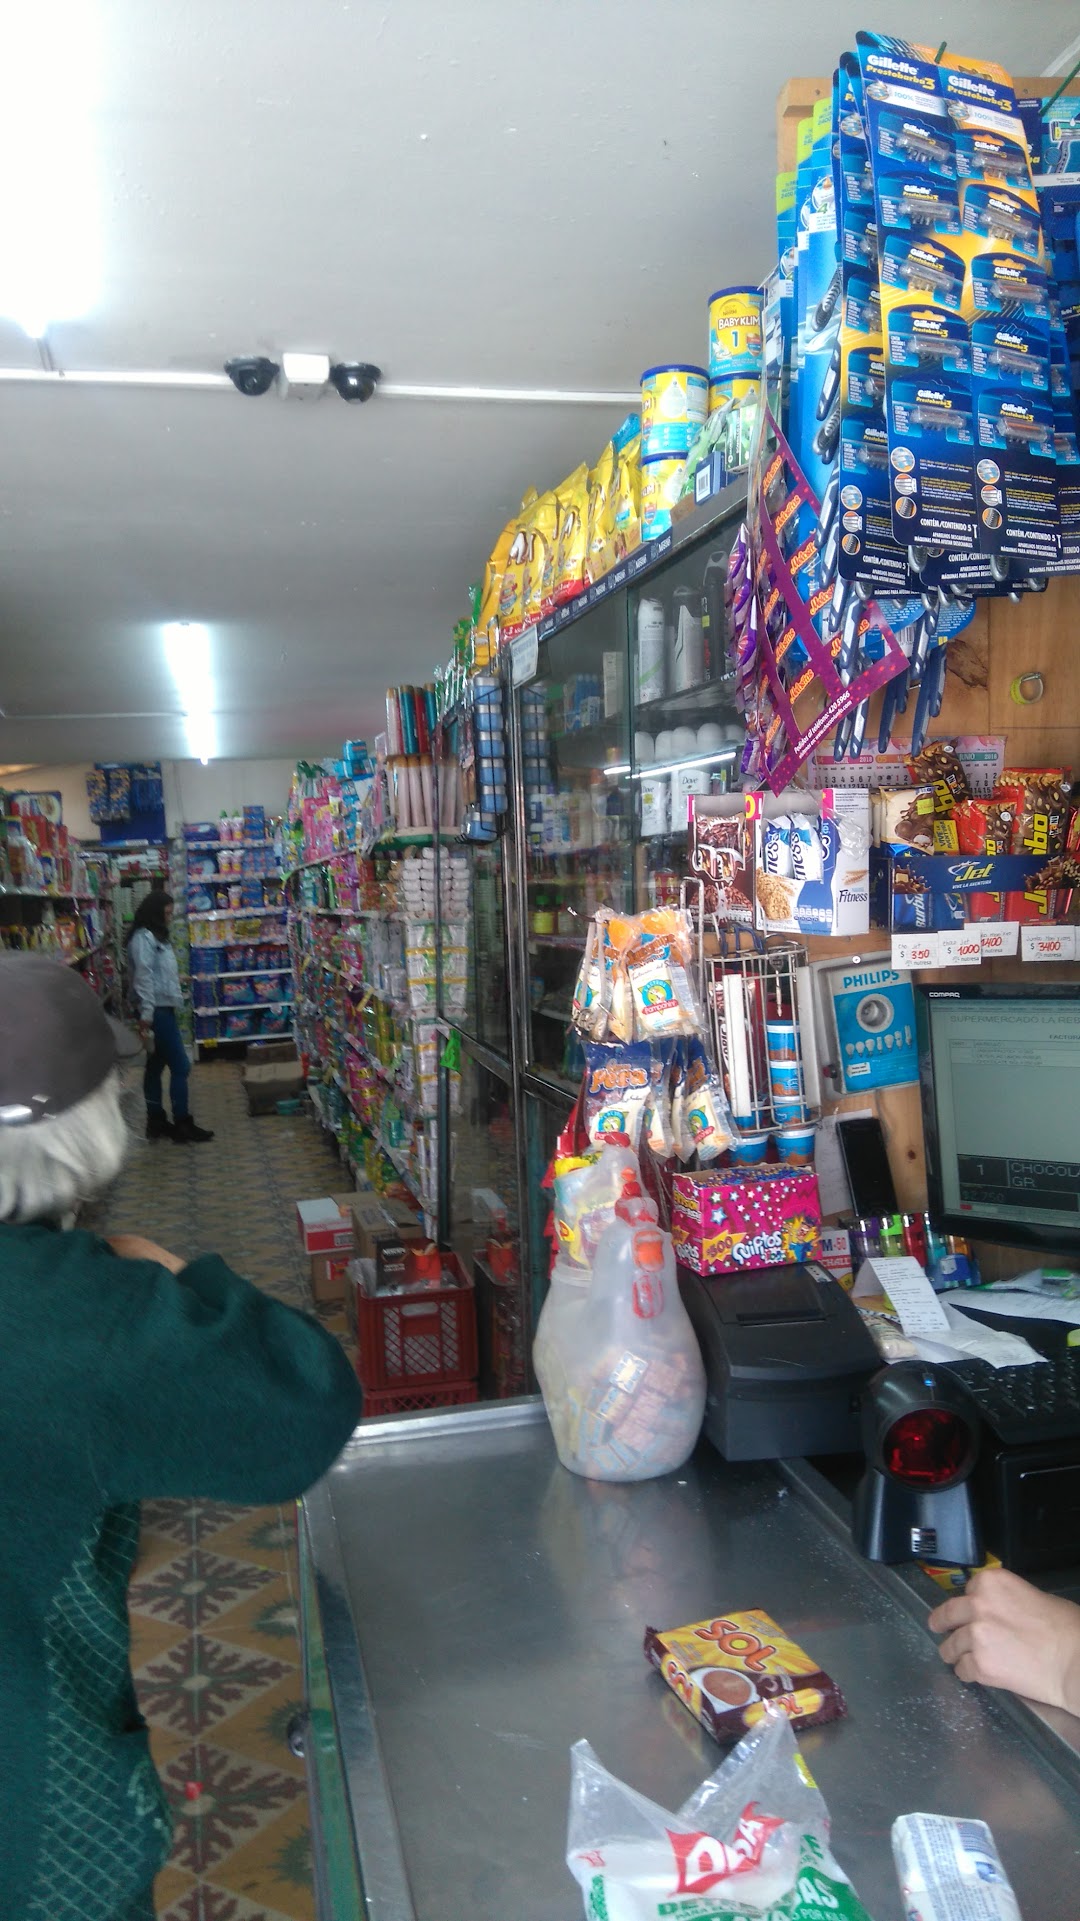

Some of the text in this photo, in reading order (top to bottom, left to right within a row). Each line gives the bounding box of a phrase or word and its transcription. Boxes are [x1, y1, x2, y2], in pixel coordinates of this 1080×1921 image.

[867, 54, 918, 75] Gillette
[948, 75, 997, 96] Gillette
[894, 90, 914, 101] 100%
[903, 122, 930, 137] Gillette
[974, 140, 1000, 152] Gillette
[903, 184, 931, 195] Gillette
[988, 198, 1015, 213] Gillette
[910, 248, 938, 263] Gillette
[994, 267, 1021, 278] Gillette
[718, 316, 760, 330] BABY KLIM
[913, 319, 942, 330] Gillette
[732, 331, 738, 348] 1
[996, 332, 1023, 344] Gillette
[917, 390, 946, 400] Gillette
[1001, 402, 1028, 415] Gillette
[828, 702, 838, 714] 420
[836, 690, 850, 706] 5966
[682, 776, 698, 784] Dove
[954, 862, 996, 882] Jet
[839, 890, 868, 902] Fitness
[957, 944, 980, 956] 1000
[1038, 941, 1061, 952] 3400
[912, 950, 930, 960] 350
[843, 970, 900, 989] PHILIPS
[950, 1015, 1038, 1024] SUPERMERCADO
[976, 1164, 984, 1176] 1
[1012, 1176, 1036, 1188] GR
[694, 1619, 776, 1672] SOL
[667, 1660, 694, 1702] SOL
